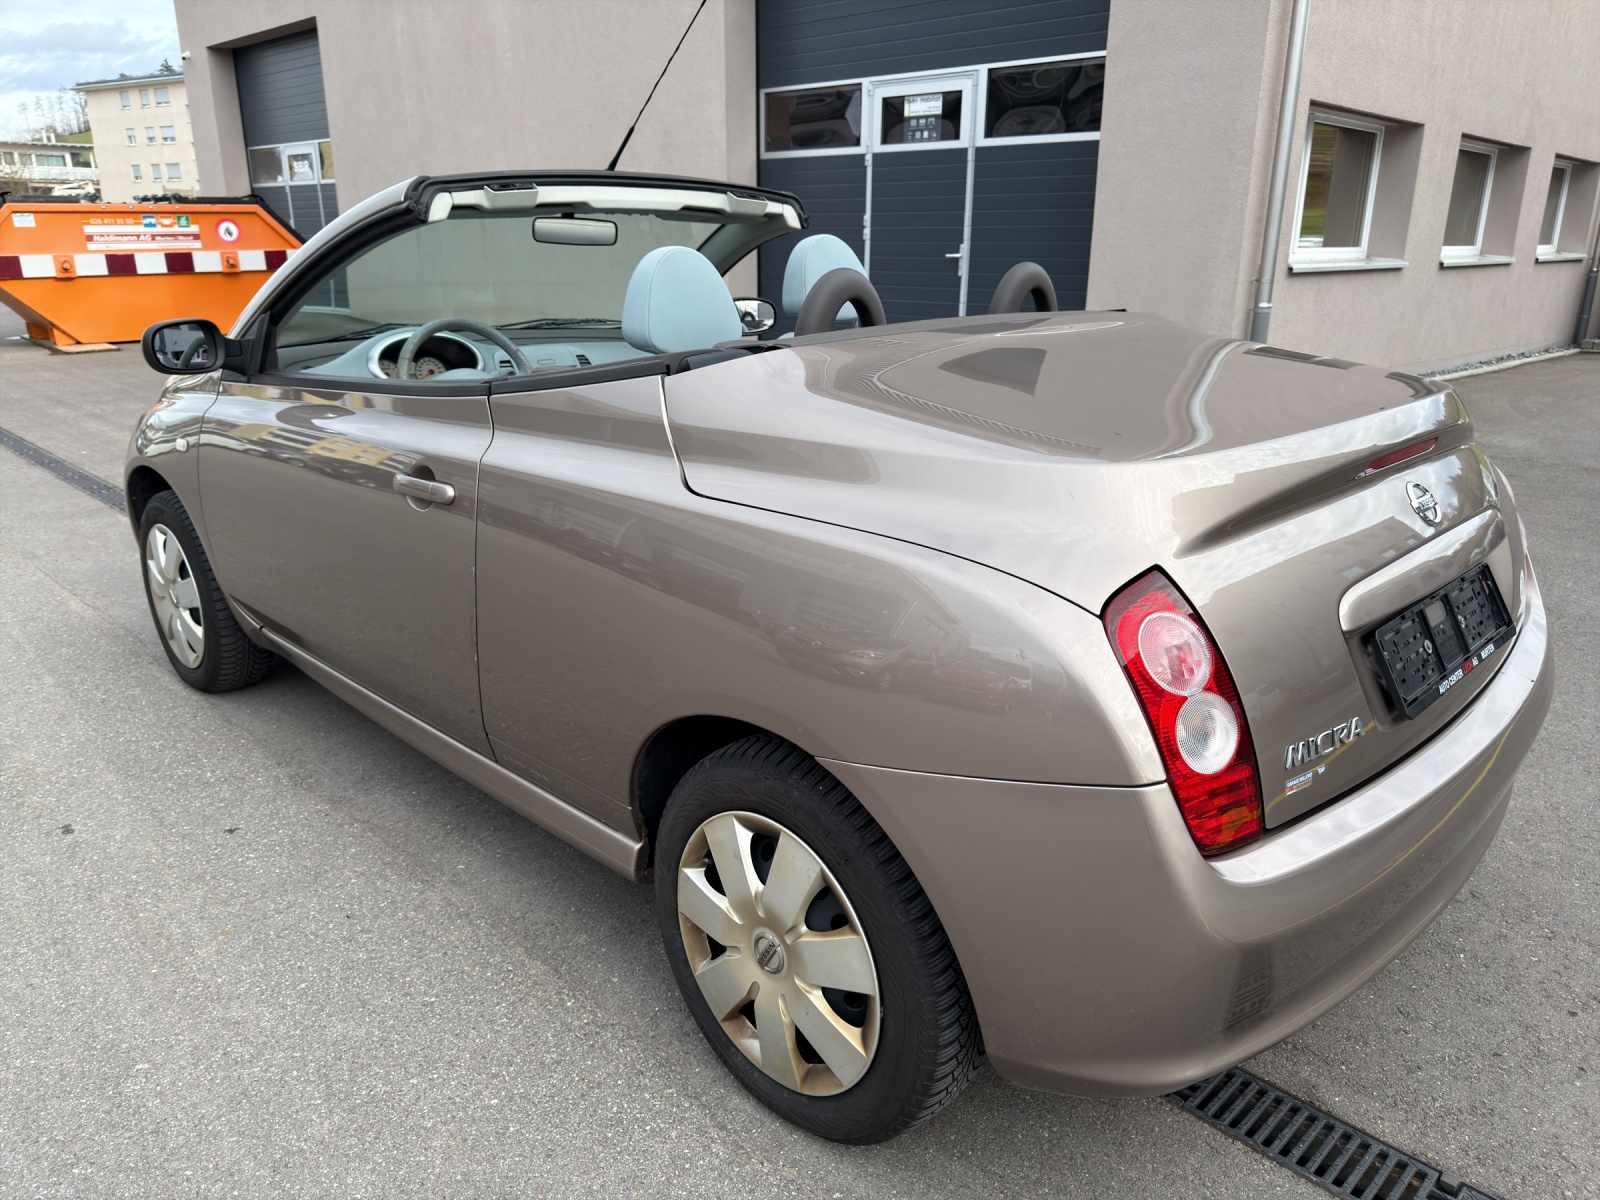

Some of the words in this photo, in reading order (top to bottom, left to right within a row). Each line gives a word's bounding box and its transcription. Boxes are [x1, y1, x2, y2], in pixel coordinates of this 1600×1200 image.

[1439, 680, 1450, 694] AUTO
[1449, 669, 1464, 686] CENTER
[1285, 717, 1364, 770] MICRA
[758, 941, 776, 965] NISSAN
